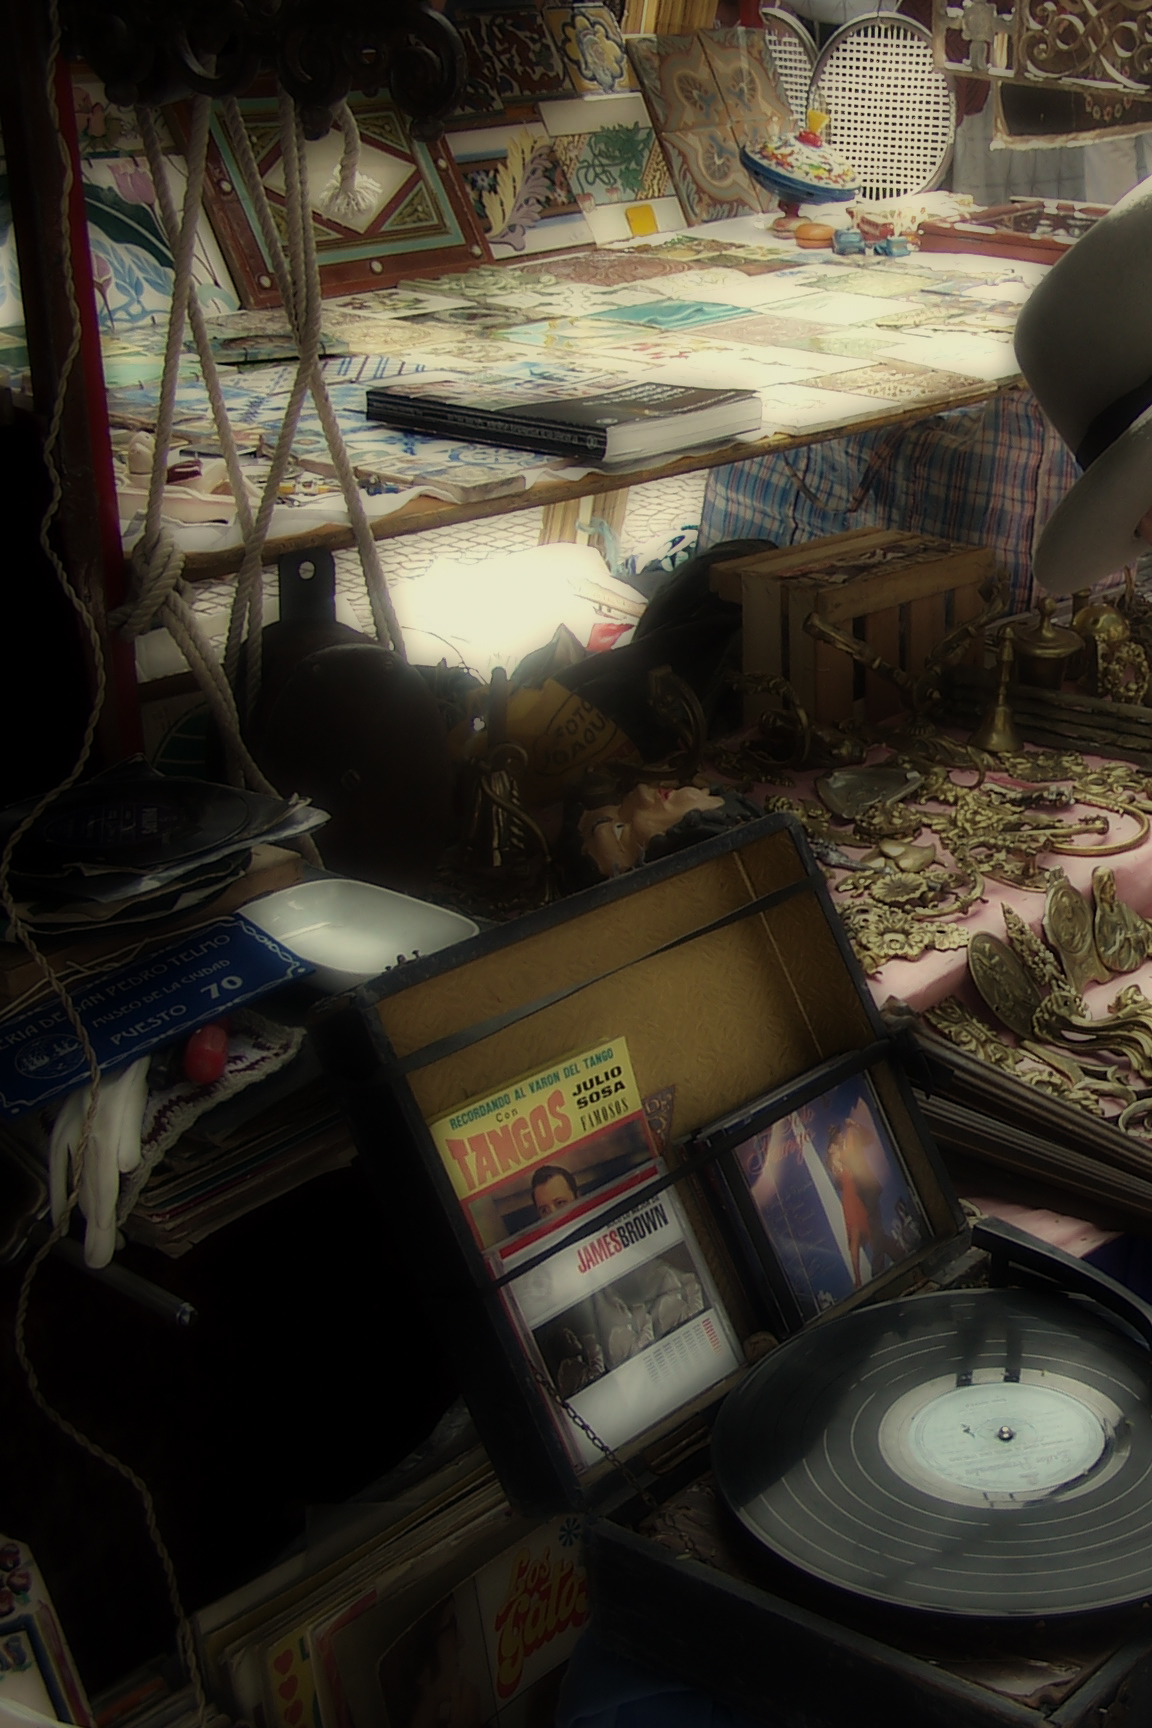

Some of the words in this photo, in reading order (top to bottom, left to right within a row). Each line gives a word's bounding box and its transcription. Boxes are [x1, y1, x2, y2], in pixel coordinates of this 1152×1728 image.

[38, 1011, 68, 1029] DE
[105, 963, 168, 997] PEDRO
[166, 934, 231, 966] TELMO
[91, 1000, 142, 1029] MUSEO
[142, 990, 164, 1004] DE
[161, 981, 182, 994] LA
[181, 959, 231, 984] CIUDAD
[109, 1004, 188, 1046] PUESTO
[200, 975, 244, 1000] 70
[449, 1093, 511, 1131] RECORDANDO
[514, 1088, 527, 1101] AL
[528, 1072, 561, 1094] VARON
[563, 1064, 580, 1079] DEL
[583, 1048, 614, 1070] TANGO
[495, 1108, 518, 1123] Con
[572, 1066, 622, 1097] JULIO
[577, 1081, 626, 1109] SOSA
[580, 1098, 629, 1131] FAMOSOS
[445, 1089, 572, 1191] TANGOS
